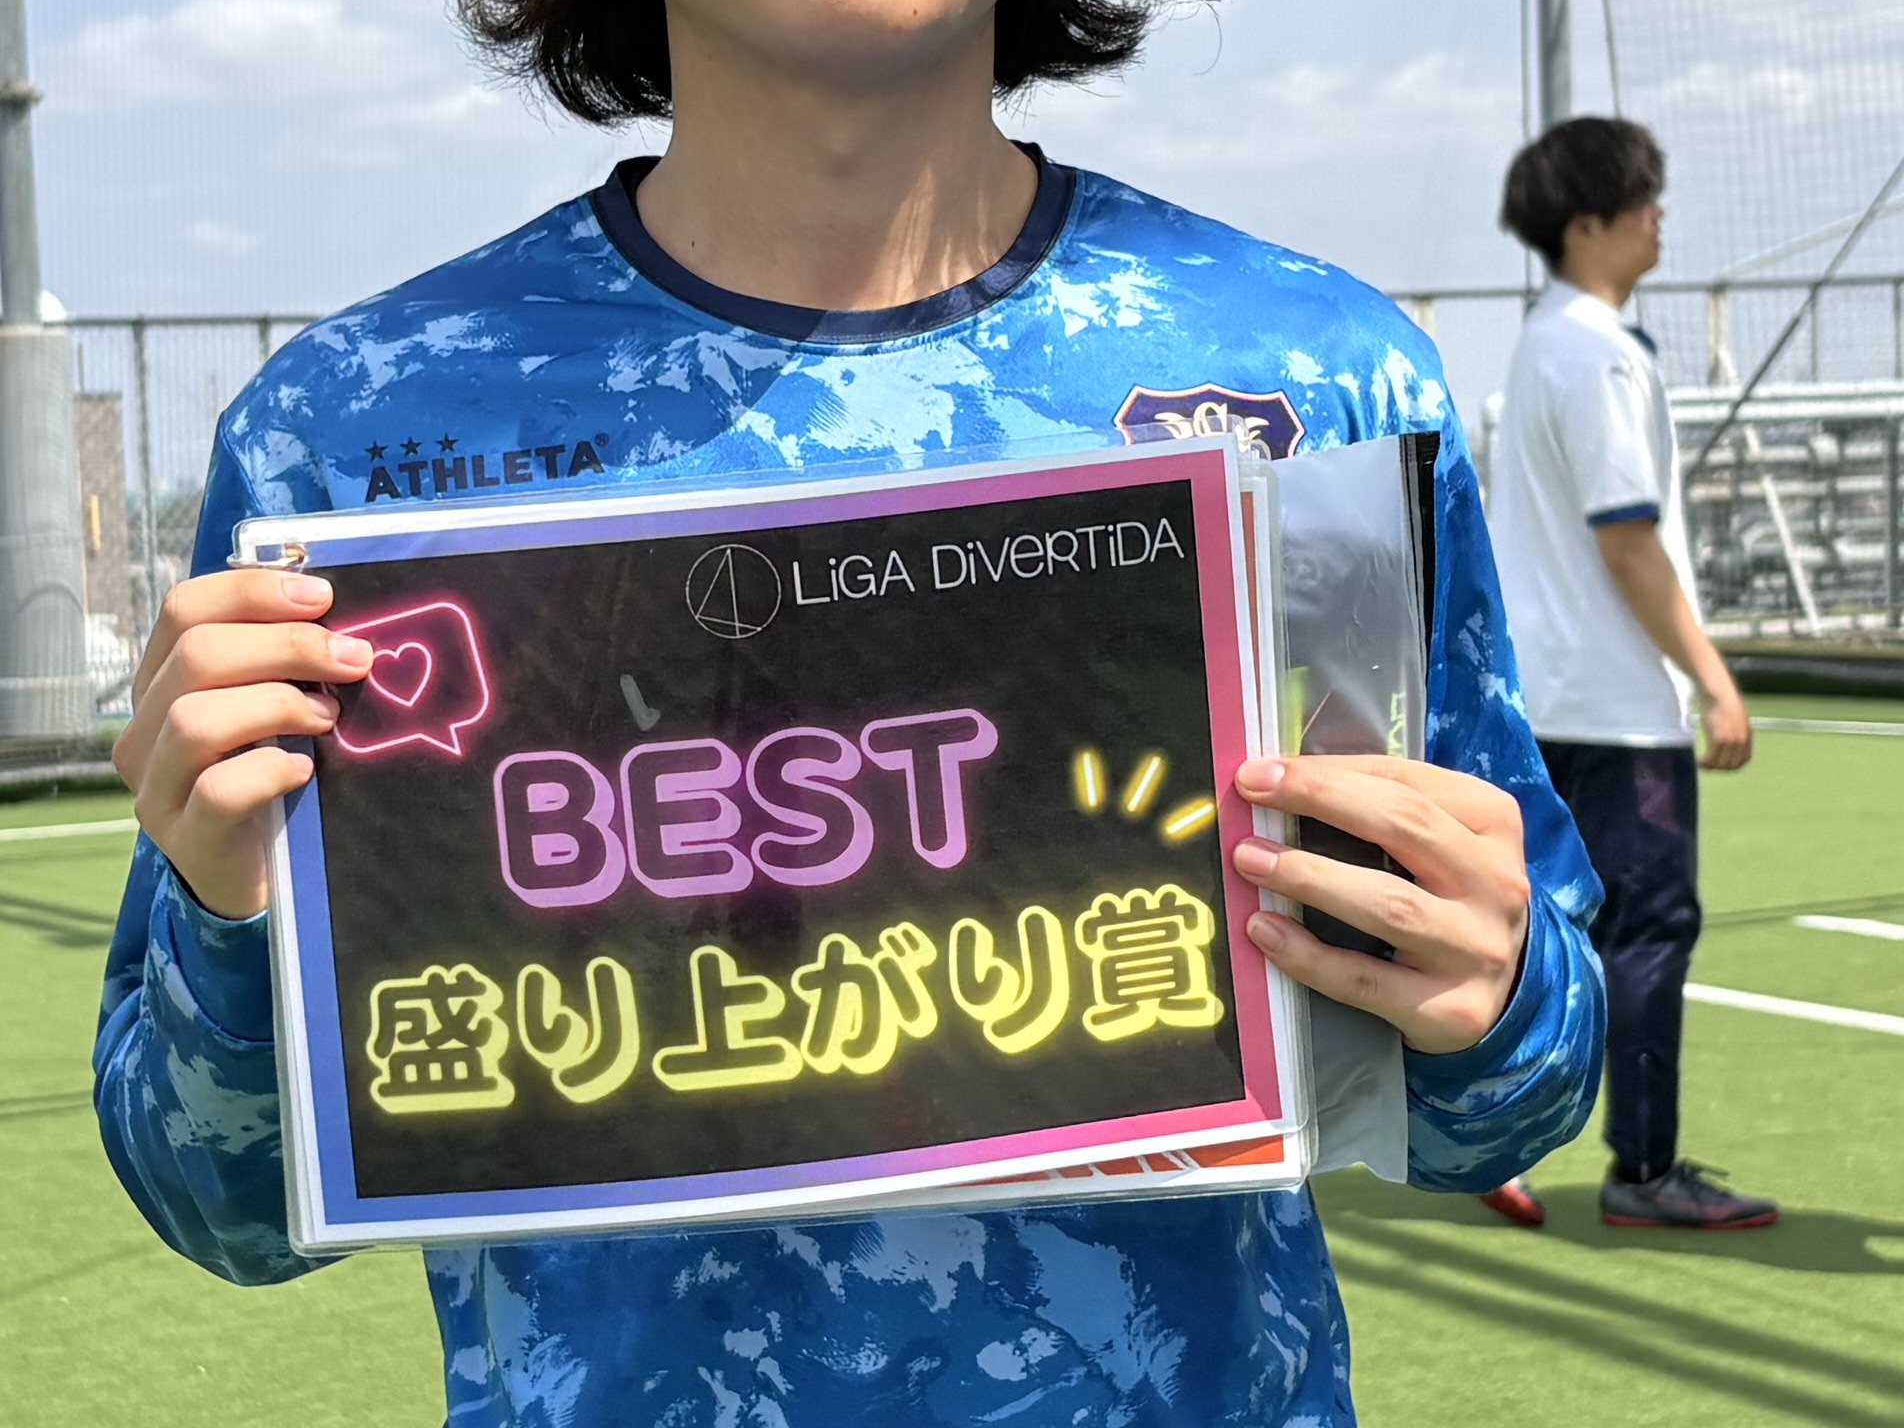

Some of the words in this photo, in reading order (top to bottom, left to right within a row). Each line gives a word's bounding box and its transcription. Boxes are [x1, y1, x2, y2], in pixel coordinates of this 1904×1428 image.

[365, 441, 604, 503] ATHLETA
[495, 708, 999, 908] BEST
[366, 884, 1225, 1115] 盛り上がり賞
